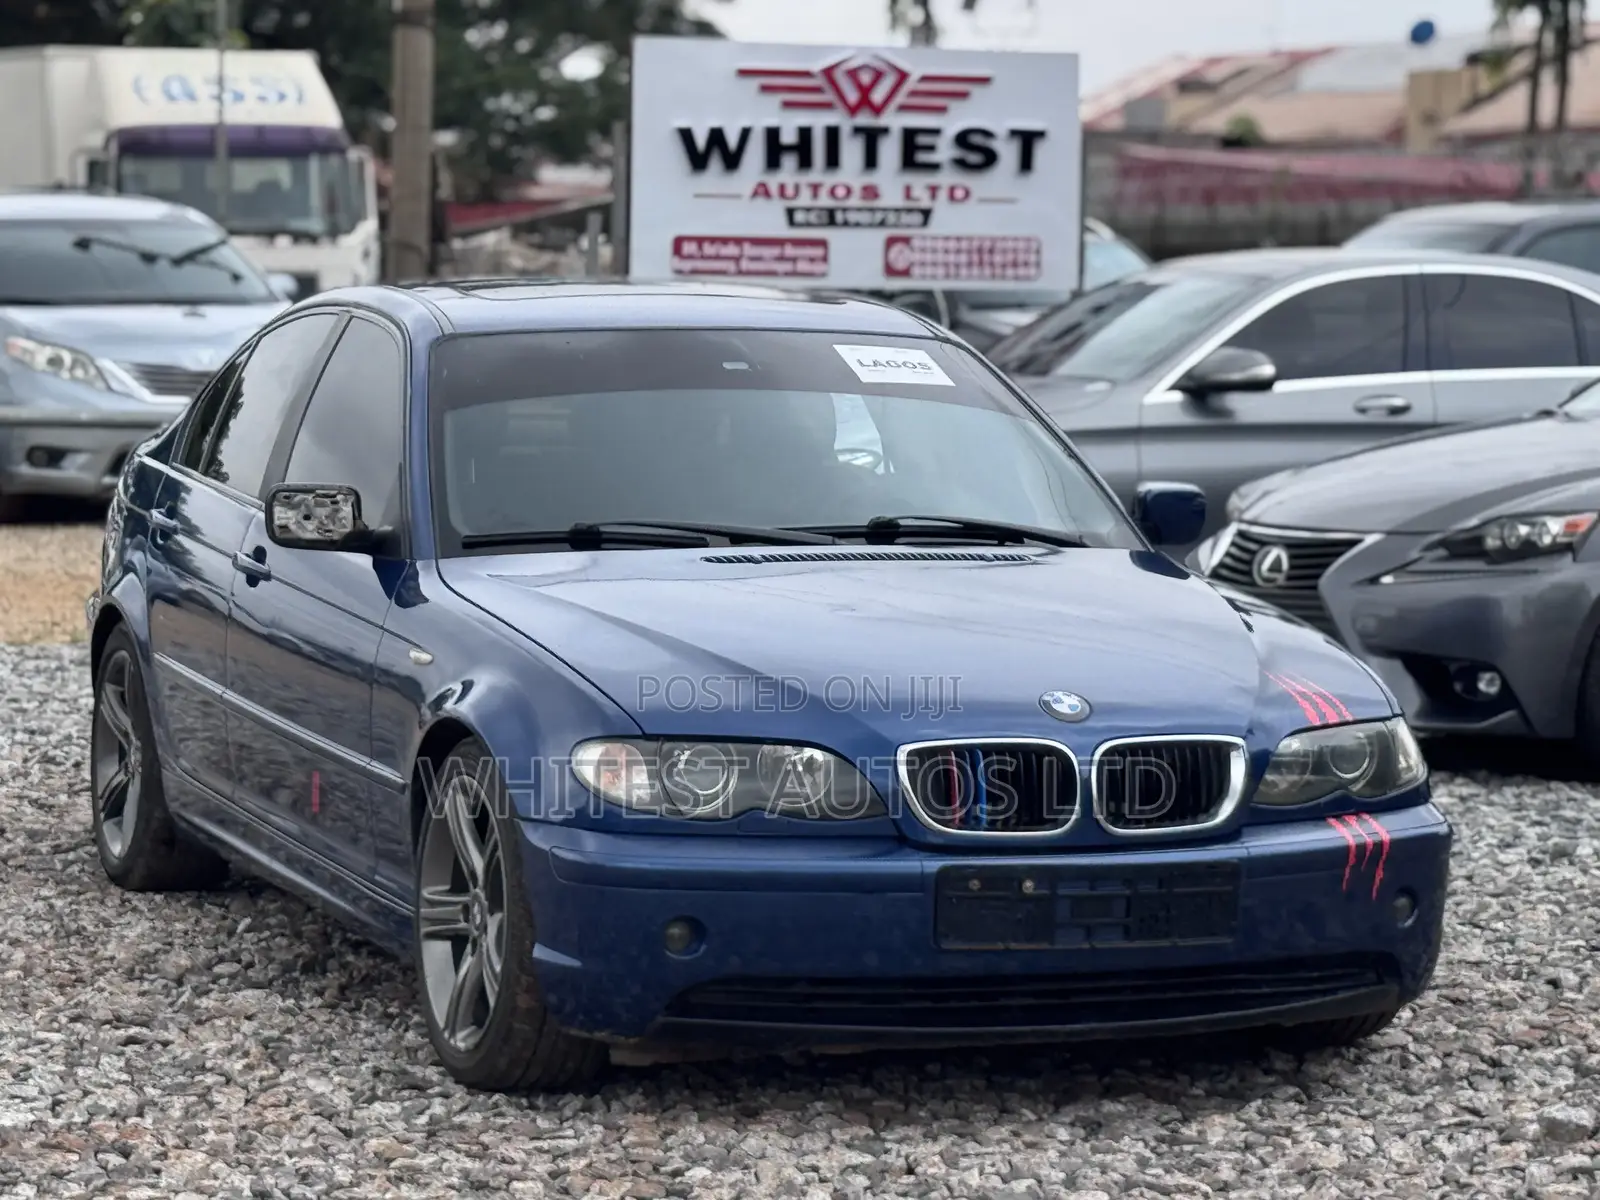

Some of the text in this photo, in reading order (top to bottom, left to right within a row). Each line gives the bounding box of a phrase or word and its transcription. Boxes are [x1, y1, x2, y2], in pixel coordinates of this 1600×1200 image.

[676, 124, 1047, 174] WHITEST
[751, 182, 972, 202] AUTOS LTD
[856, 358, 932, 370] LAGOS
